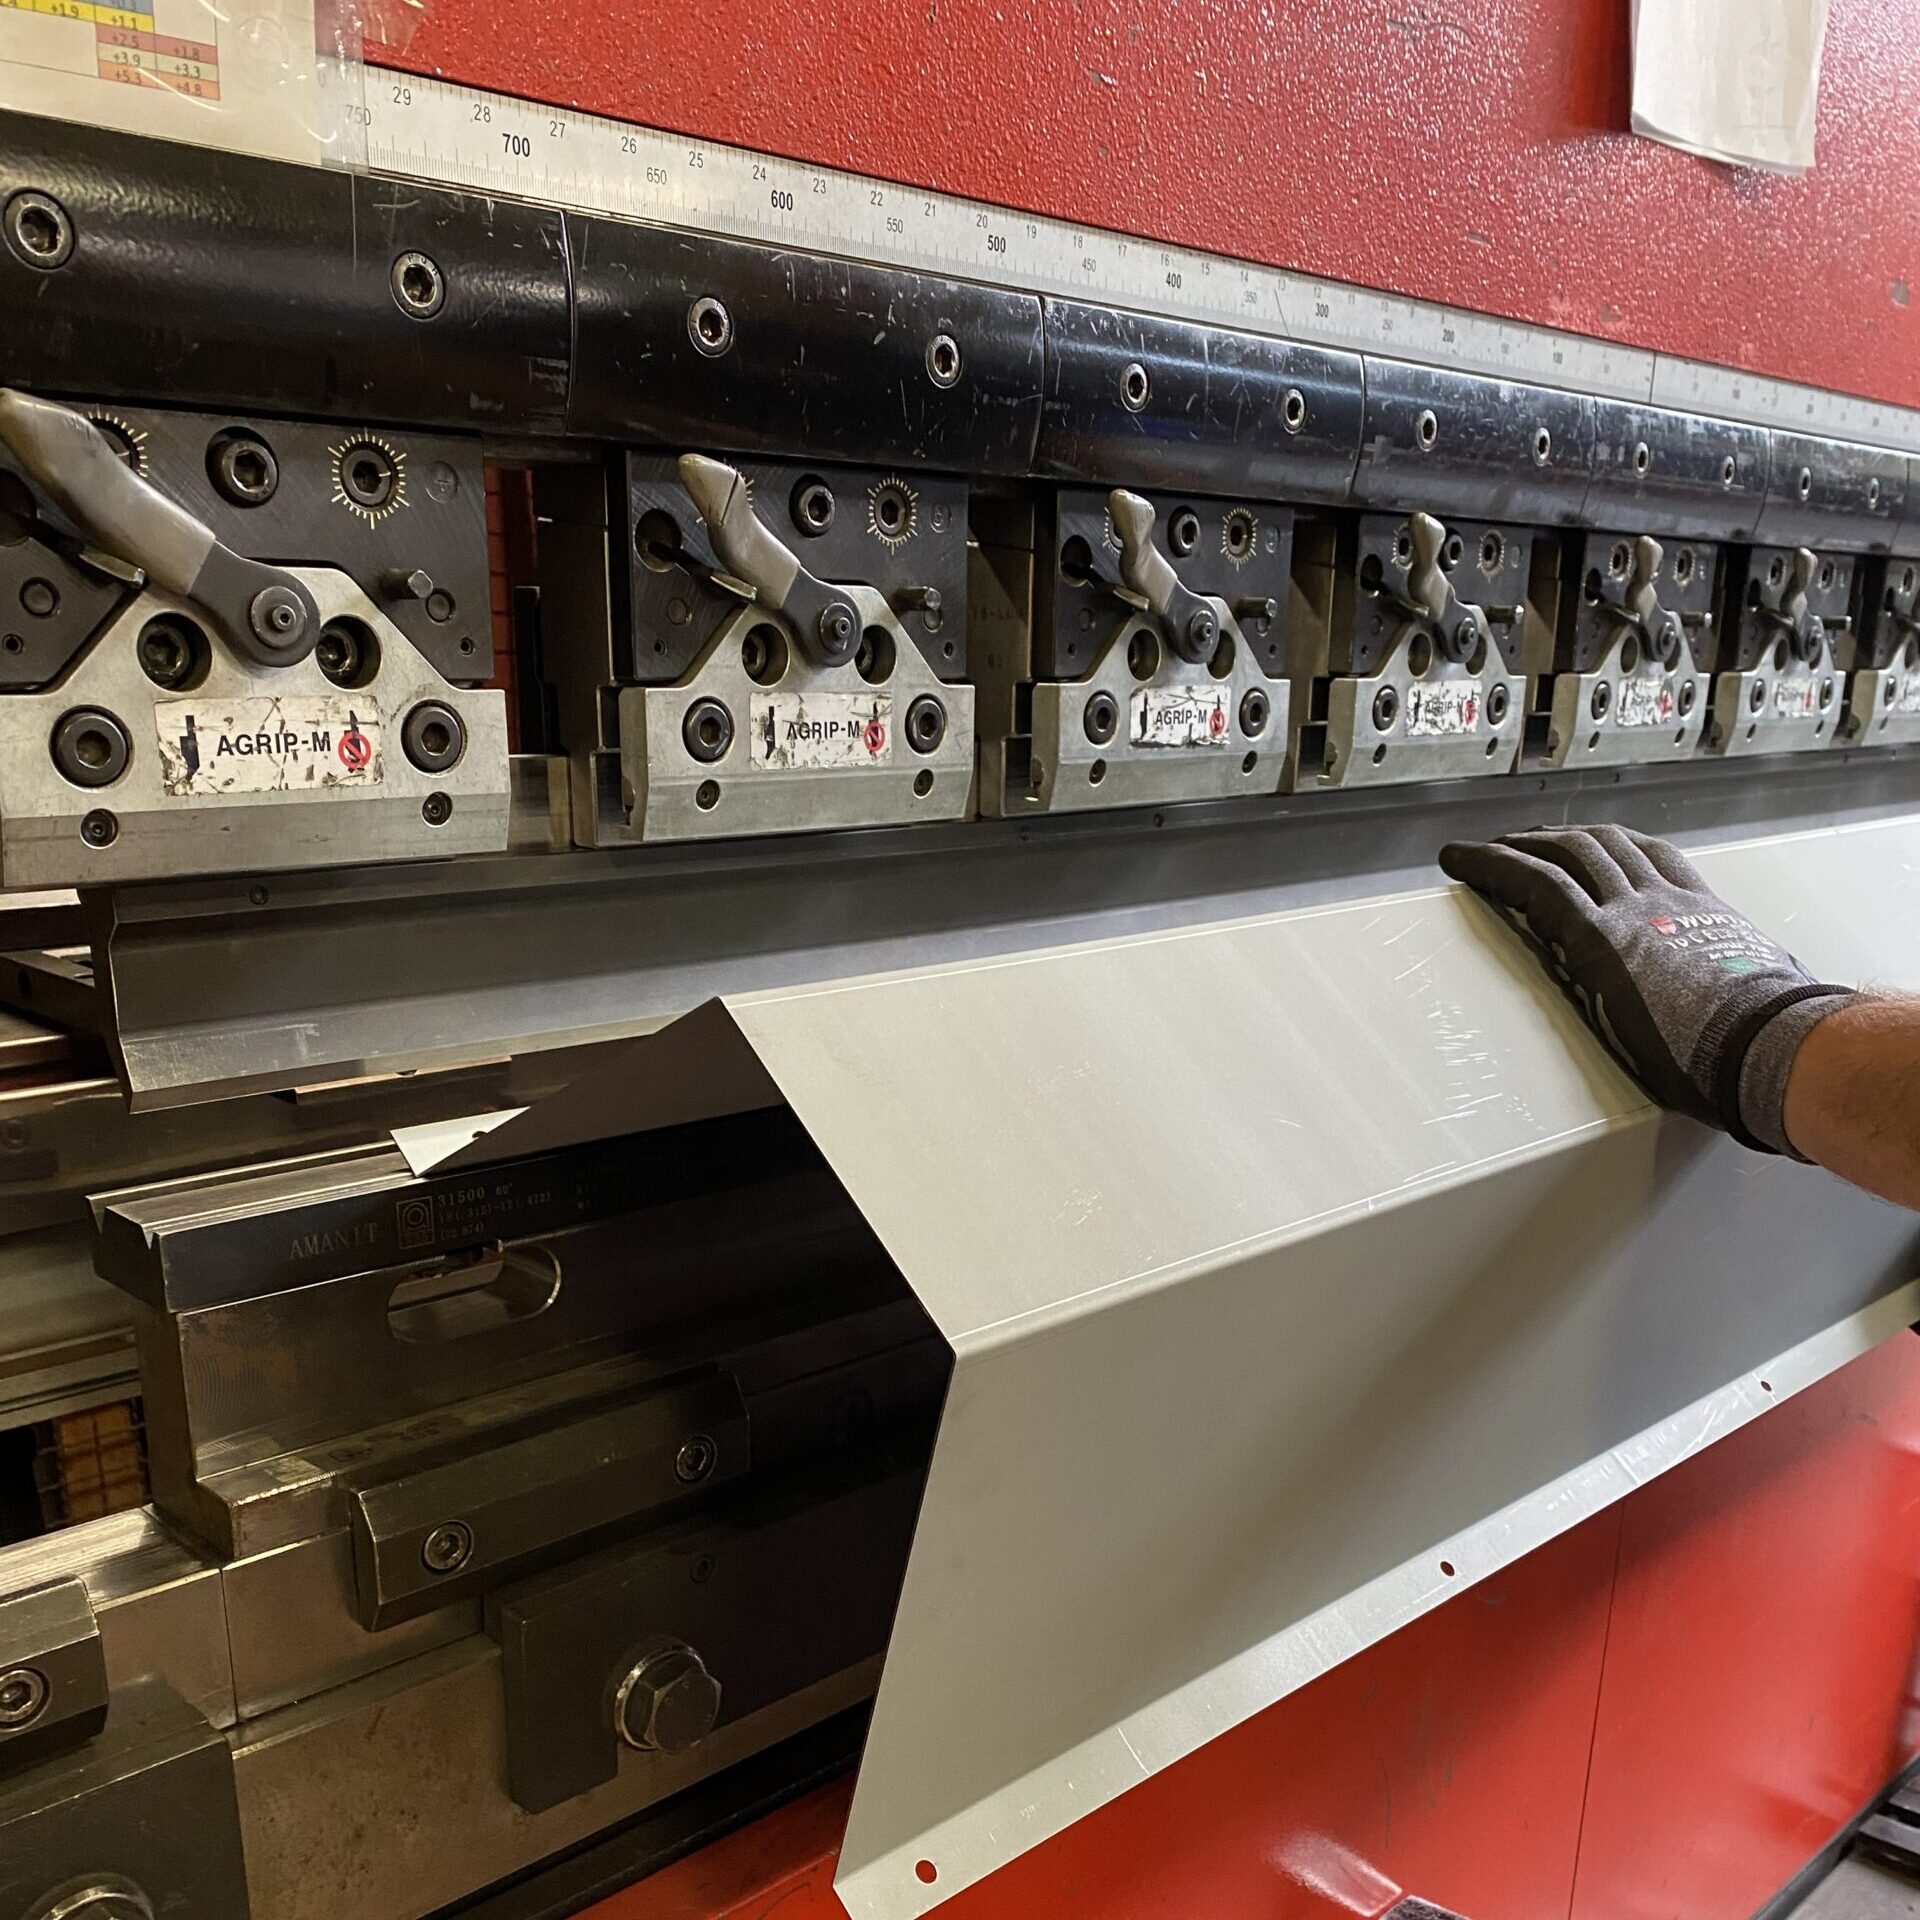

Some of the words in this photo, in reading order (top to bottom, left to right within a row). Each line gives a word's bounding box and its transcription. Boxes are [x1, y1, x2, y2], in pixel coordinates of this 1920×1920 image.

[113, 52, 141, 66] +3.9
[174, 64, 200, 79] +3.3
[392, 86, 412, 106] 29
[473, 104, 491, 123] 28
[549, 121, 566, 138] 27
[621, 136, 637, 155] 26
[688, 151, 704, 169] 25
[752, 165, 766, 182] 24
[813, 177, 826, 194] 23
[870, 191, 883, 207] 22
[924, 202, 936, 217] 21
[976, 214, 988, 229] 20
[1026, 224, 1037, 239] 19
[1073, 235, 1083, 248] 18
[1118, 245, 1127, 258] 17
[502, 133, 531, 158] 700
[646, 167, 668, 185] 650
[770, 190, 794, 211] 600
[886, 217, 904, 234] 550
[988, 235, 1006, 253] 500
[1082, 256, 1097, 273] 450
[1166, 272, 1182, 289] 400
[1315, 303, 1329, 318] 300
[1155, 708, 1207, 725] AGRIP-M
[217, 730, 331, 756] AGRIP-M
[786, 720, 860, 740] AGRIP-M
[438, 1186, 485, 1208] 31500
[290, 1222, 378, 1259] AMANIT
